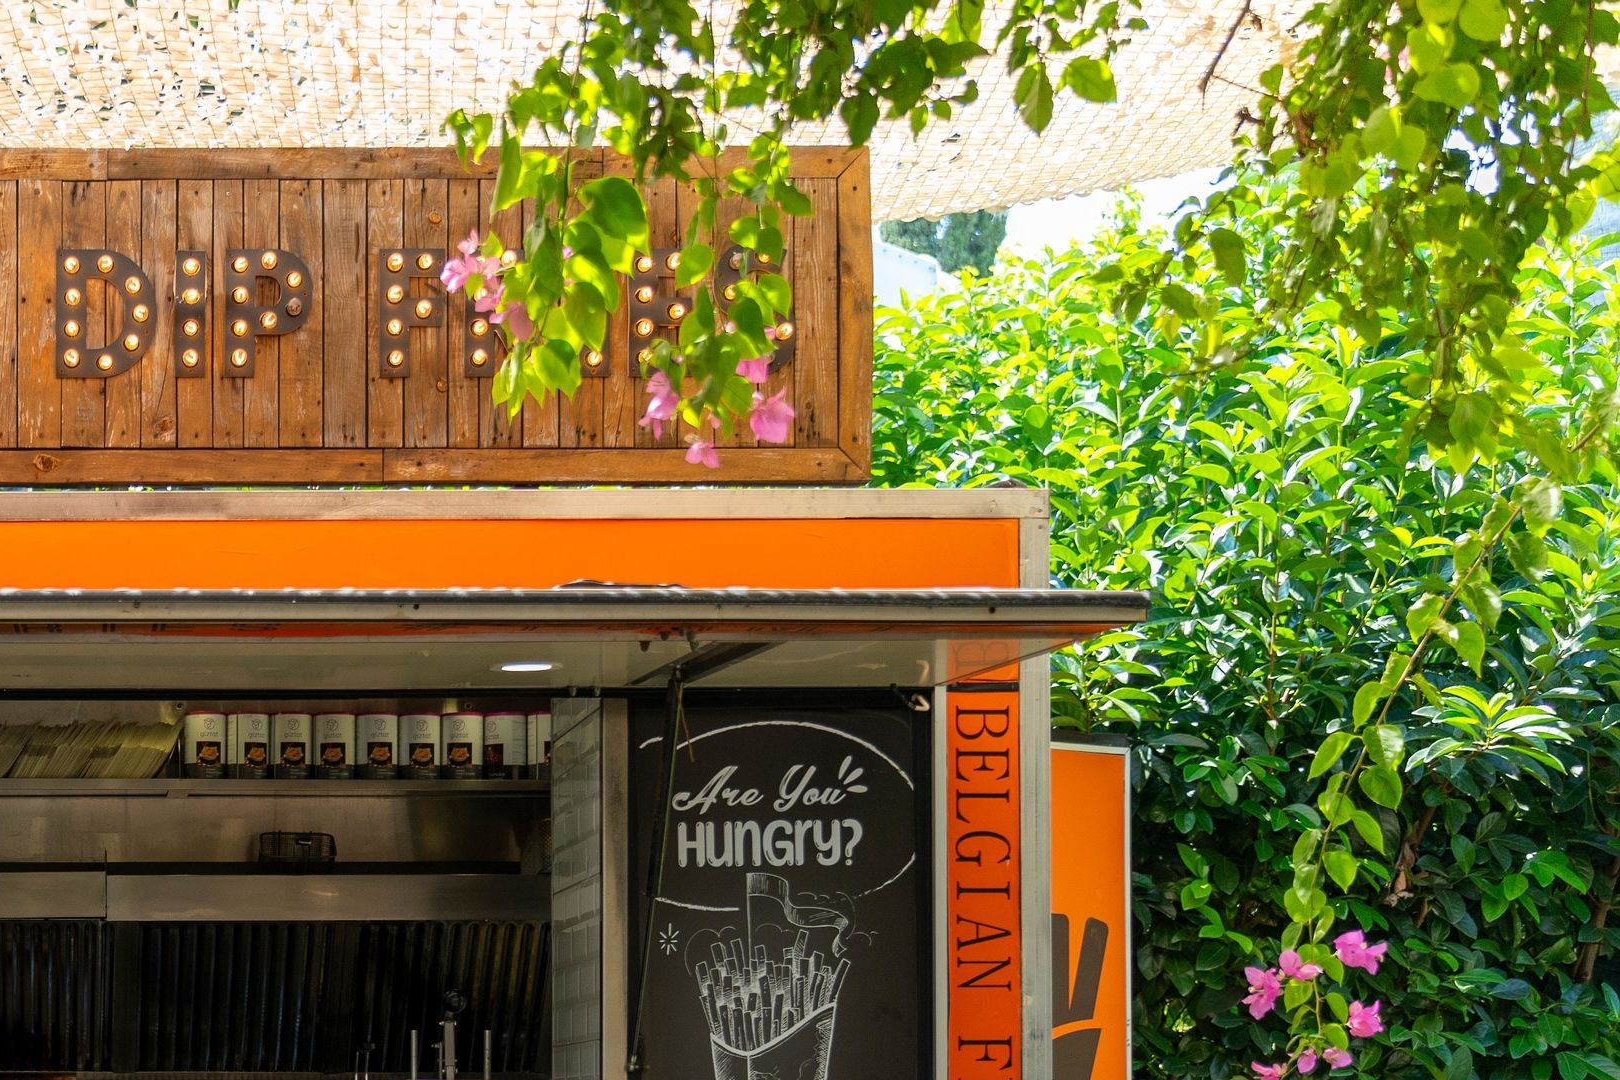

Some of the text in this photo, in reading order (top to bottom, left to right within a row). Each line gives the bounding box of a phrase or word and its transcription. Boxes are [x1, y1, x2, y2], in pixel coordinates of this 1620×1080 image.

[55, 248, 313, 379] DIP
[671, 764, 846, 815] Are You
[954, 705, 1011, 992] BELGIAN
